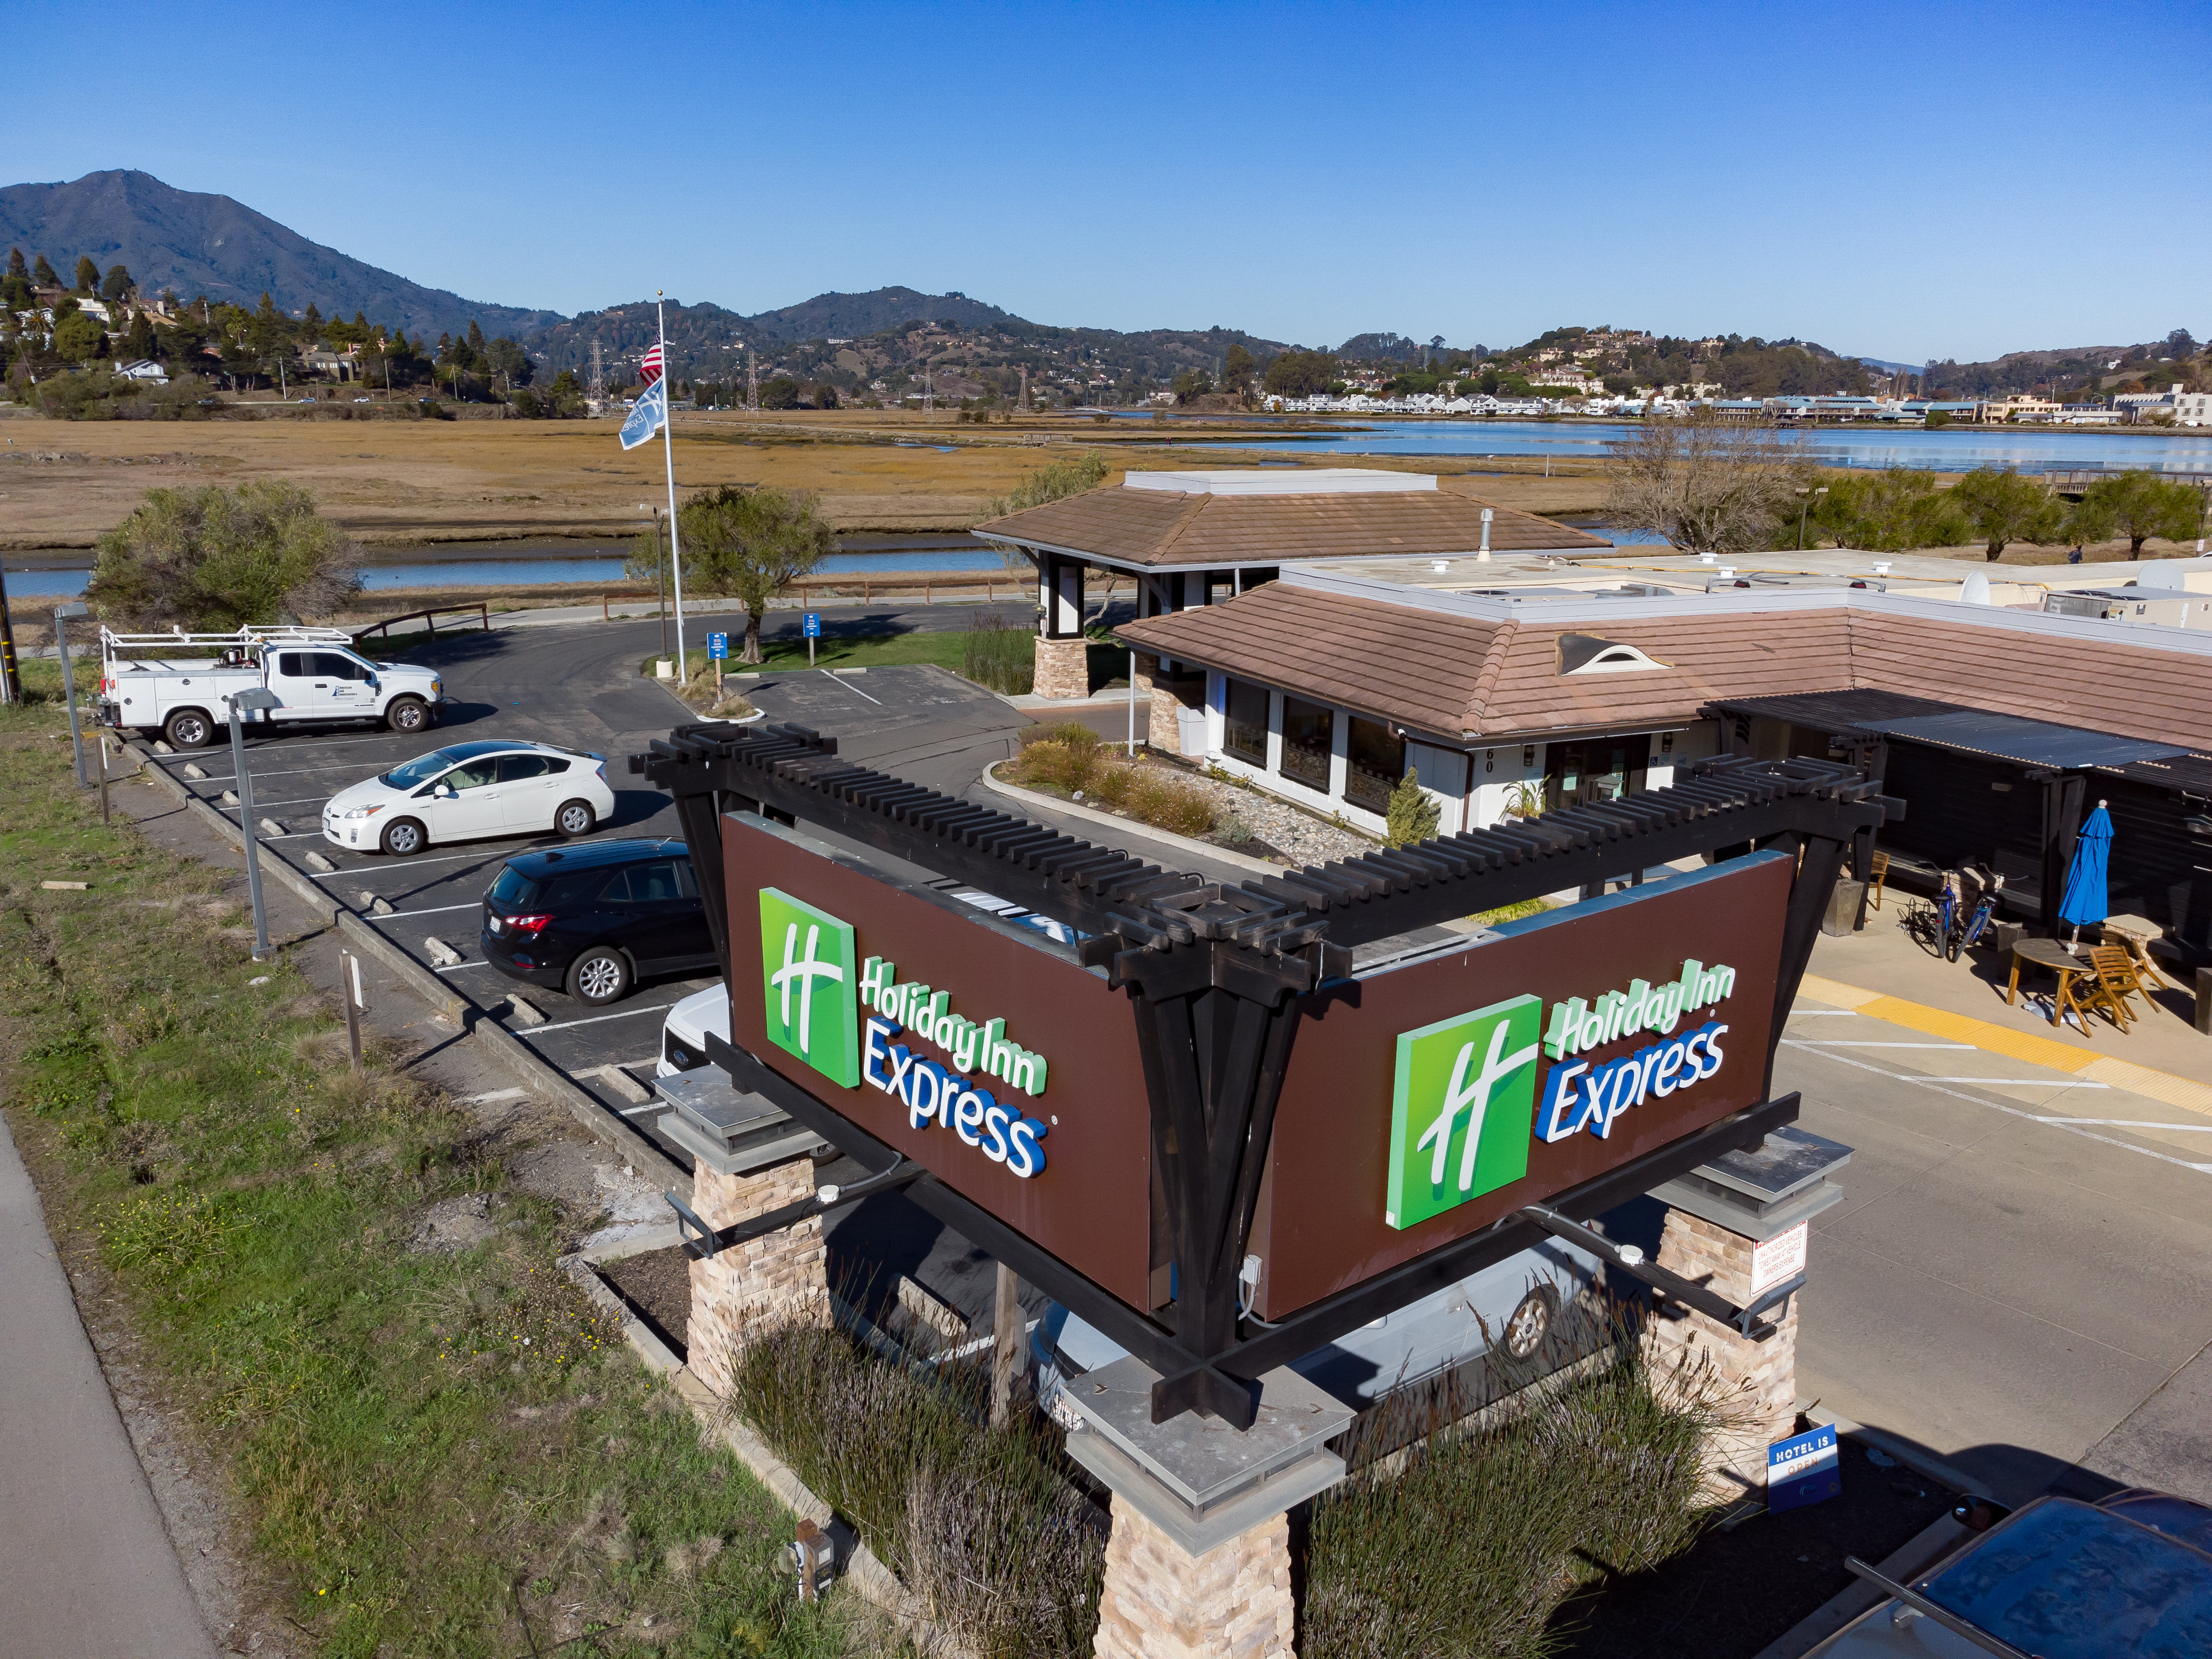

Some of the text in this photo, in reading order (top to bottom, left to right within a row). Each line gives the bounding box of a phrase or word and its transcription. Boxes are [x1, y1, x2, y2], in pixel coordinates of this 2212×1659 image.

[1545, 959, 1735, 1061] Holiday Inn
[859, 956, 1047, 1096] Holiday Inn
[863, 1015, 1046, 1178] Express
[1535, 1021, 1729, 1143] Express
[1758, 1229, 1803, 1260] UNAUTHORIZED VEHICLES
[1758, 1256, 1771, 1269] TOWED
[1771, 1250, 1781, 1262] AWAY
[1787, 1240, 1801, 1255] VEHICLE
[1762, 1253, 1795, 1278] OWNERS EXPENSE
[1776, 1436, 1829, 1463] HOTEL IS
[1788, 1457, 1818, 1475] OPEN
